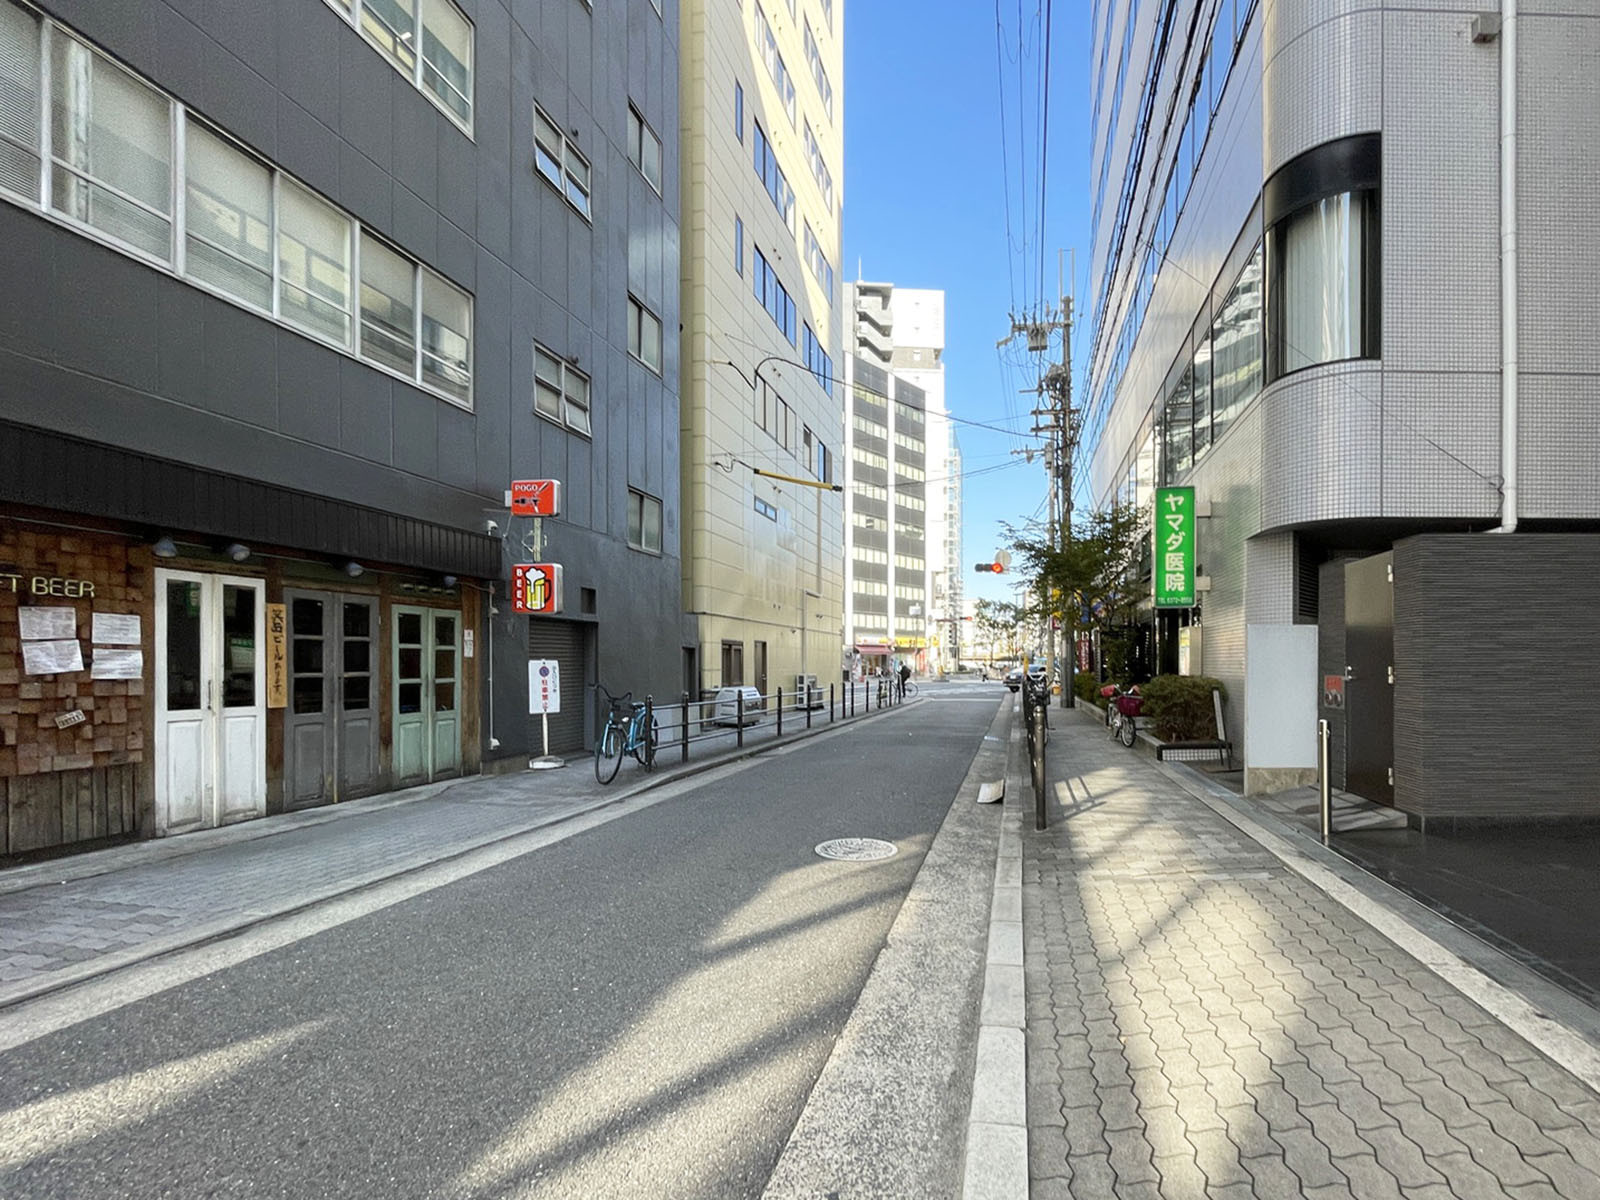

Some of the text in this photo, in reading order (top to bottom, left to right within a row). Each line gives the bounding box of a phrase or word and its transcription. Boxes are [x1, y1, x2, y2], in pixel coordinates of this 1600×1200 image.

[515, 484, 538, 492] POGO
[1165, 493, 1185, 591] ヤマダ医院
[32, 576, 96, 599] BEER
[515, 568, 523, 610] BEER
